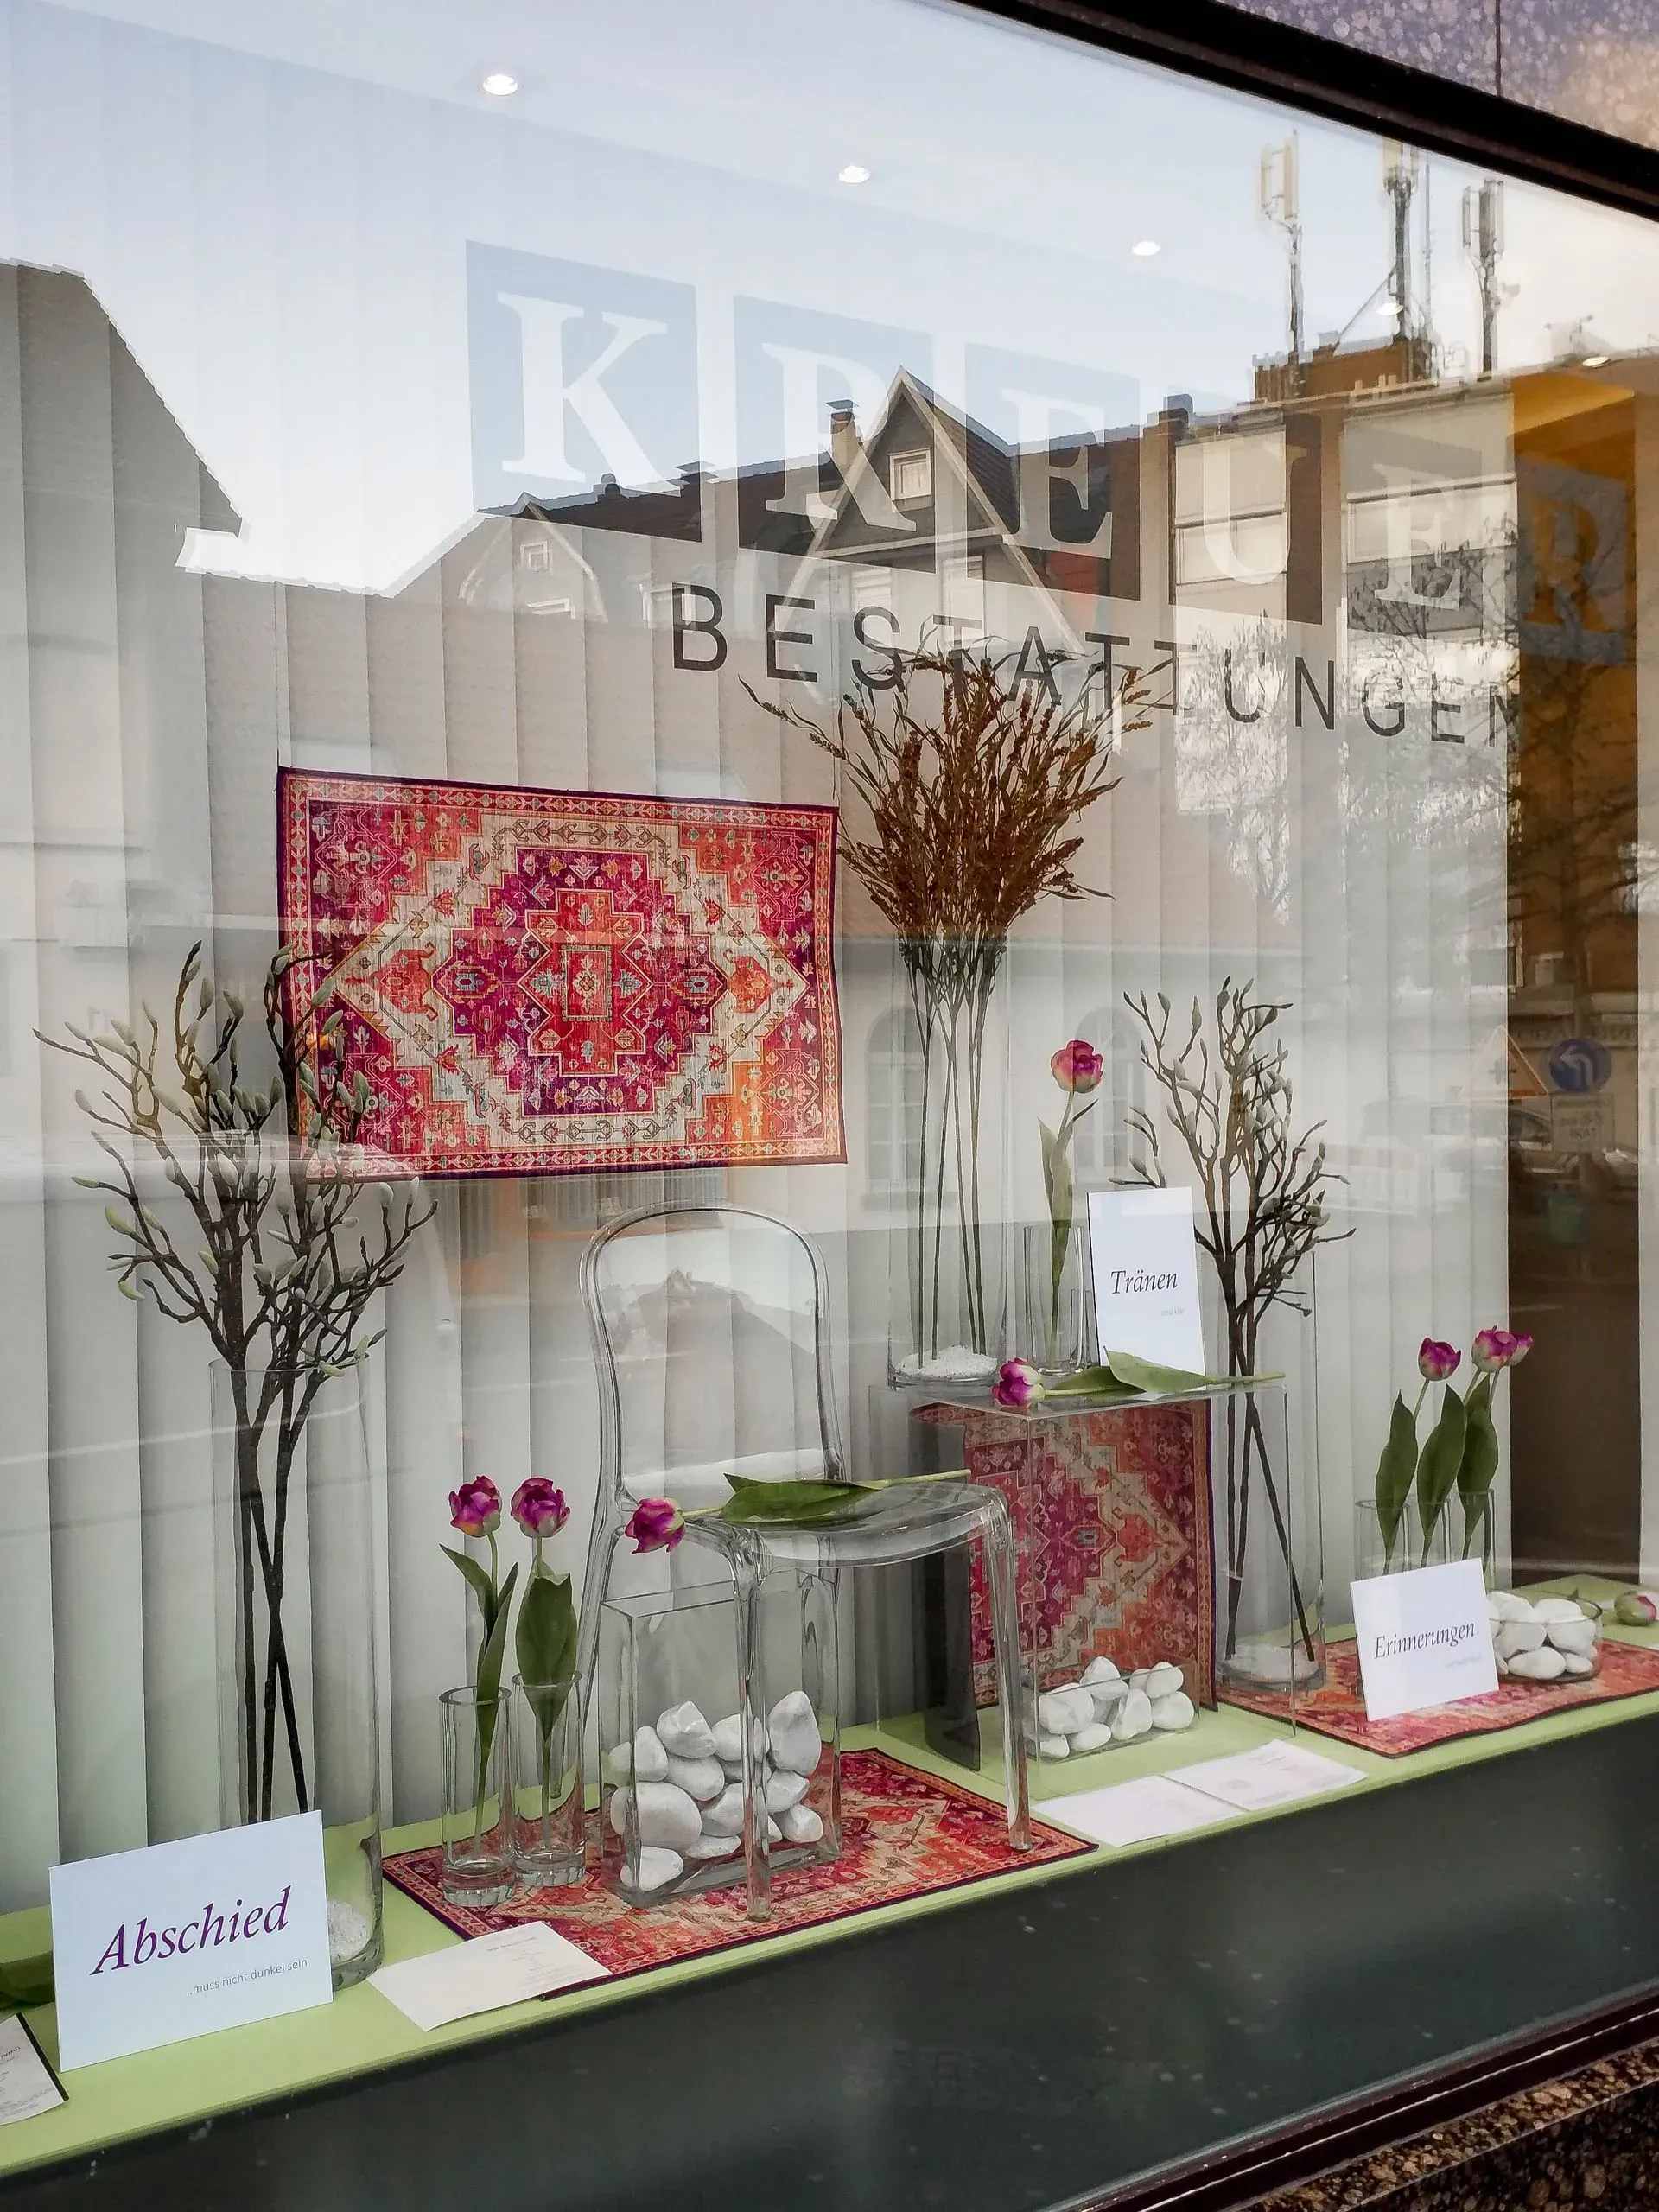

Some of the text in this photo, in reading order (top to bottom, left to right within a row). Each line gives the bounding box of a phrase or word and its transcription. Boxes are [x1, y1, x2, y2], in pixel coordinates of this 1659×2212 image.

[496, 290, 1614, 632] KREUER
[1110, 1269, 1179, 1294] Tränen
[1374, 1622, 1475, 1659] Erinnerungen
[89, 1885, 292, 1976] Abschied
[222, 1973, 248, 1986] nicht
[251, 1963, 285, 1980] dunkel
[288, 1958, 308, 1971] sein
